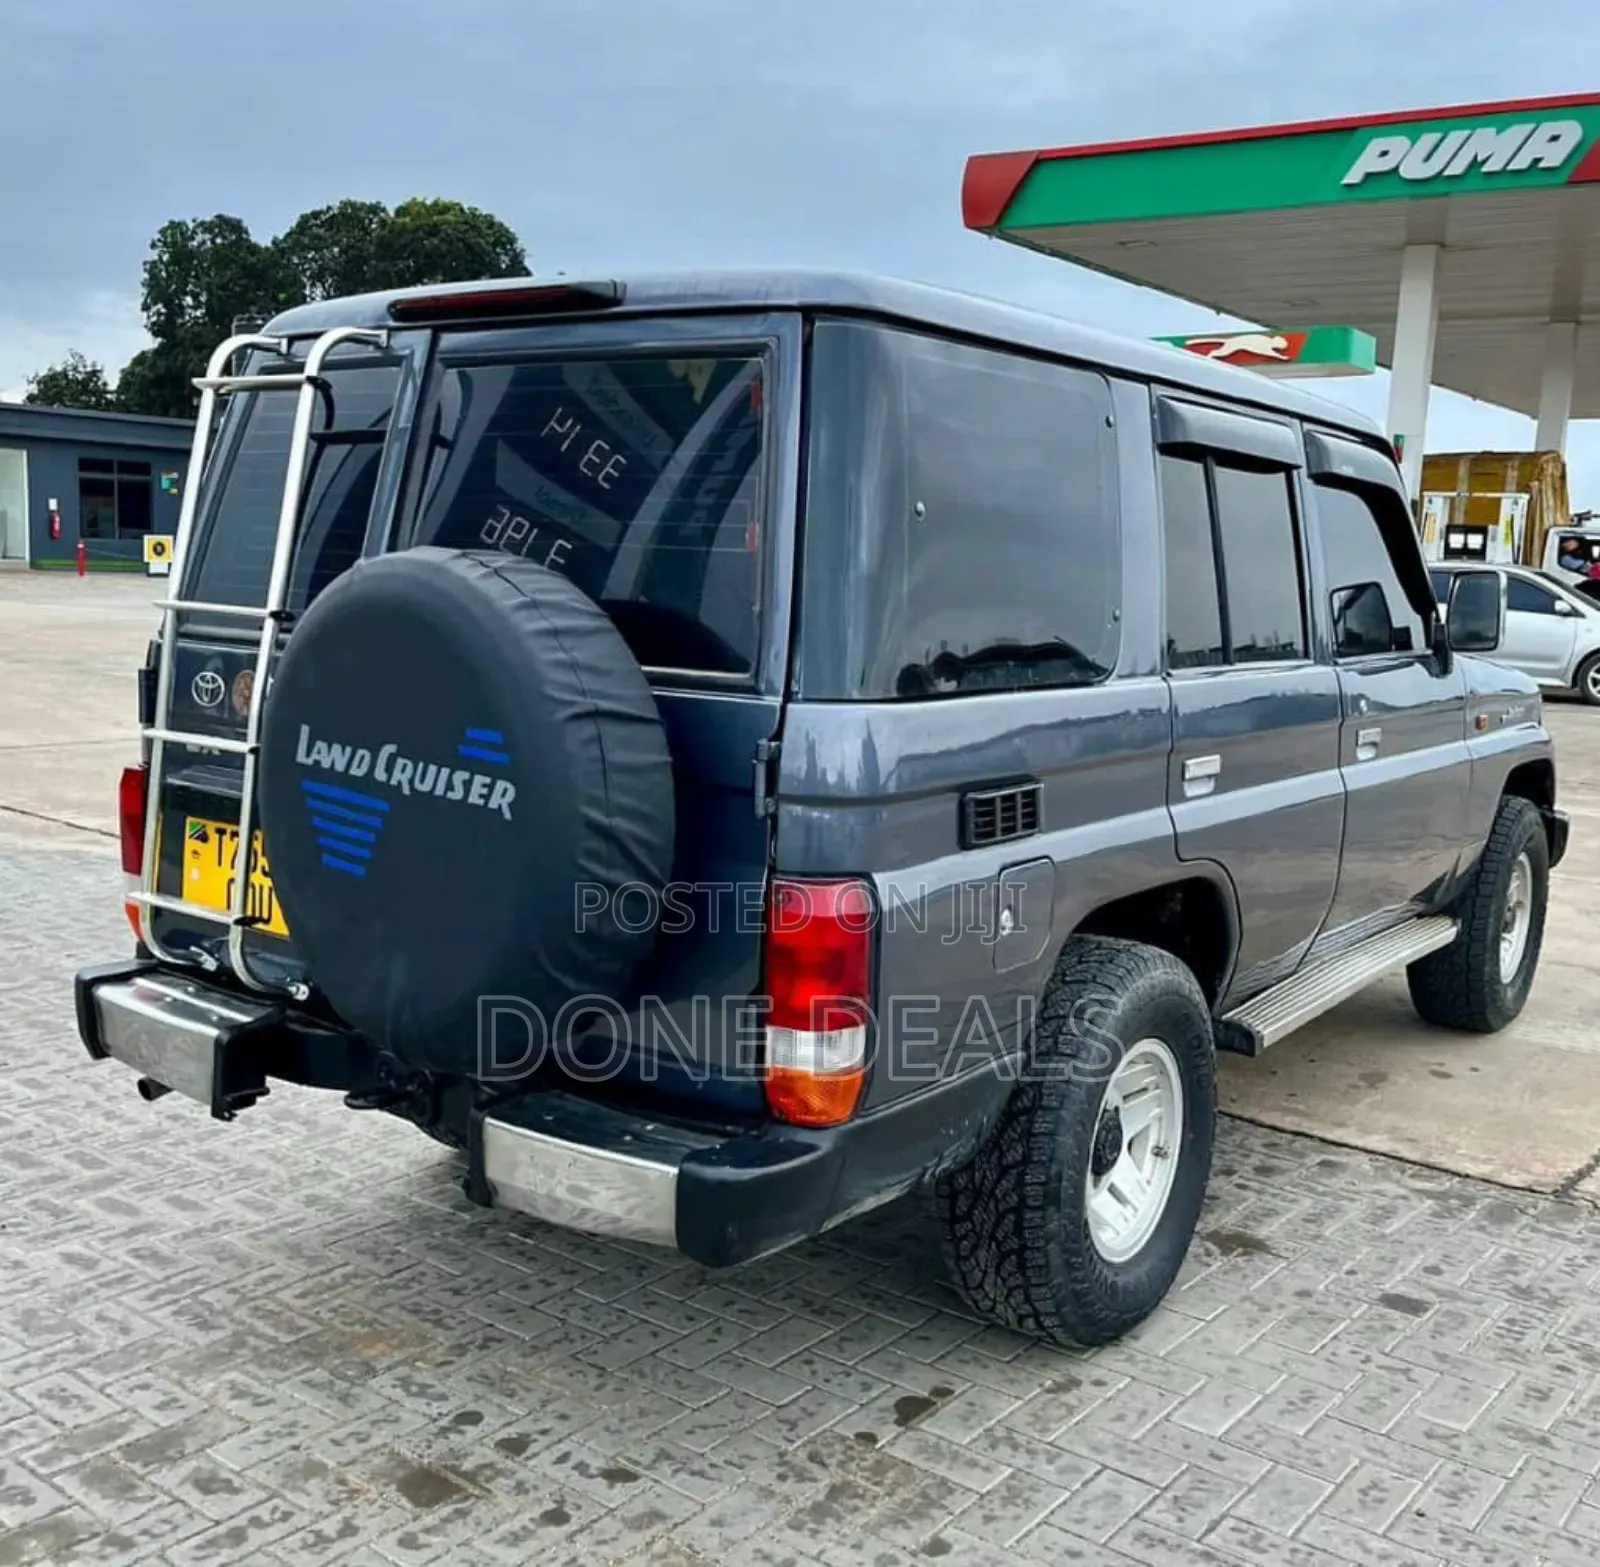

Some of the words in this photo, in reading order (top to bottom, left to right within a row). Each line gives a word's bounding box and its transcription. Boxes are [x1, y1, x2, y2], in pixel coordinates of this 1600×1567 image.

[1340, 119, 1583, 186] PUMA
[295, 723, 372, 778] LAND
[373, 743, 517, 820] CRUISER
